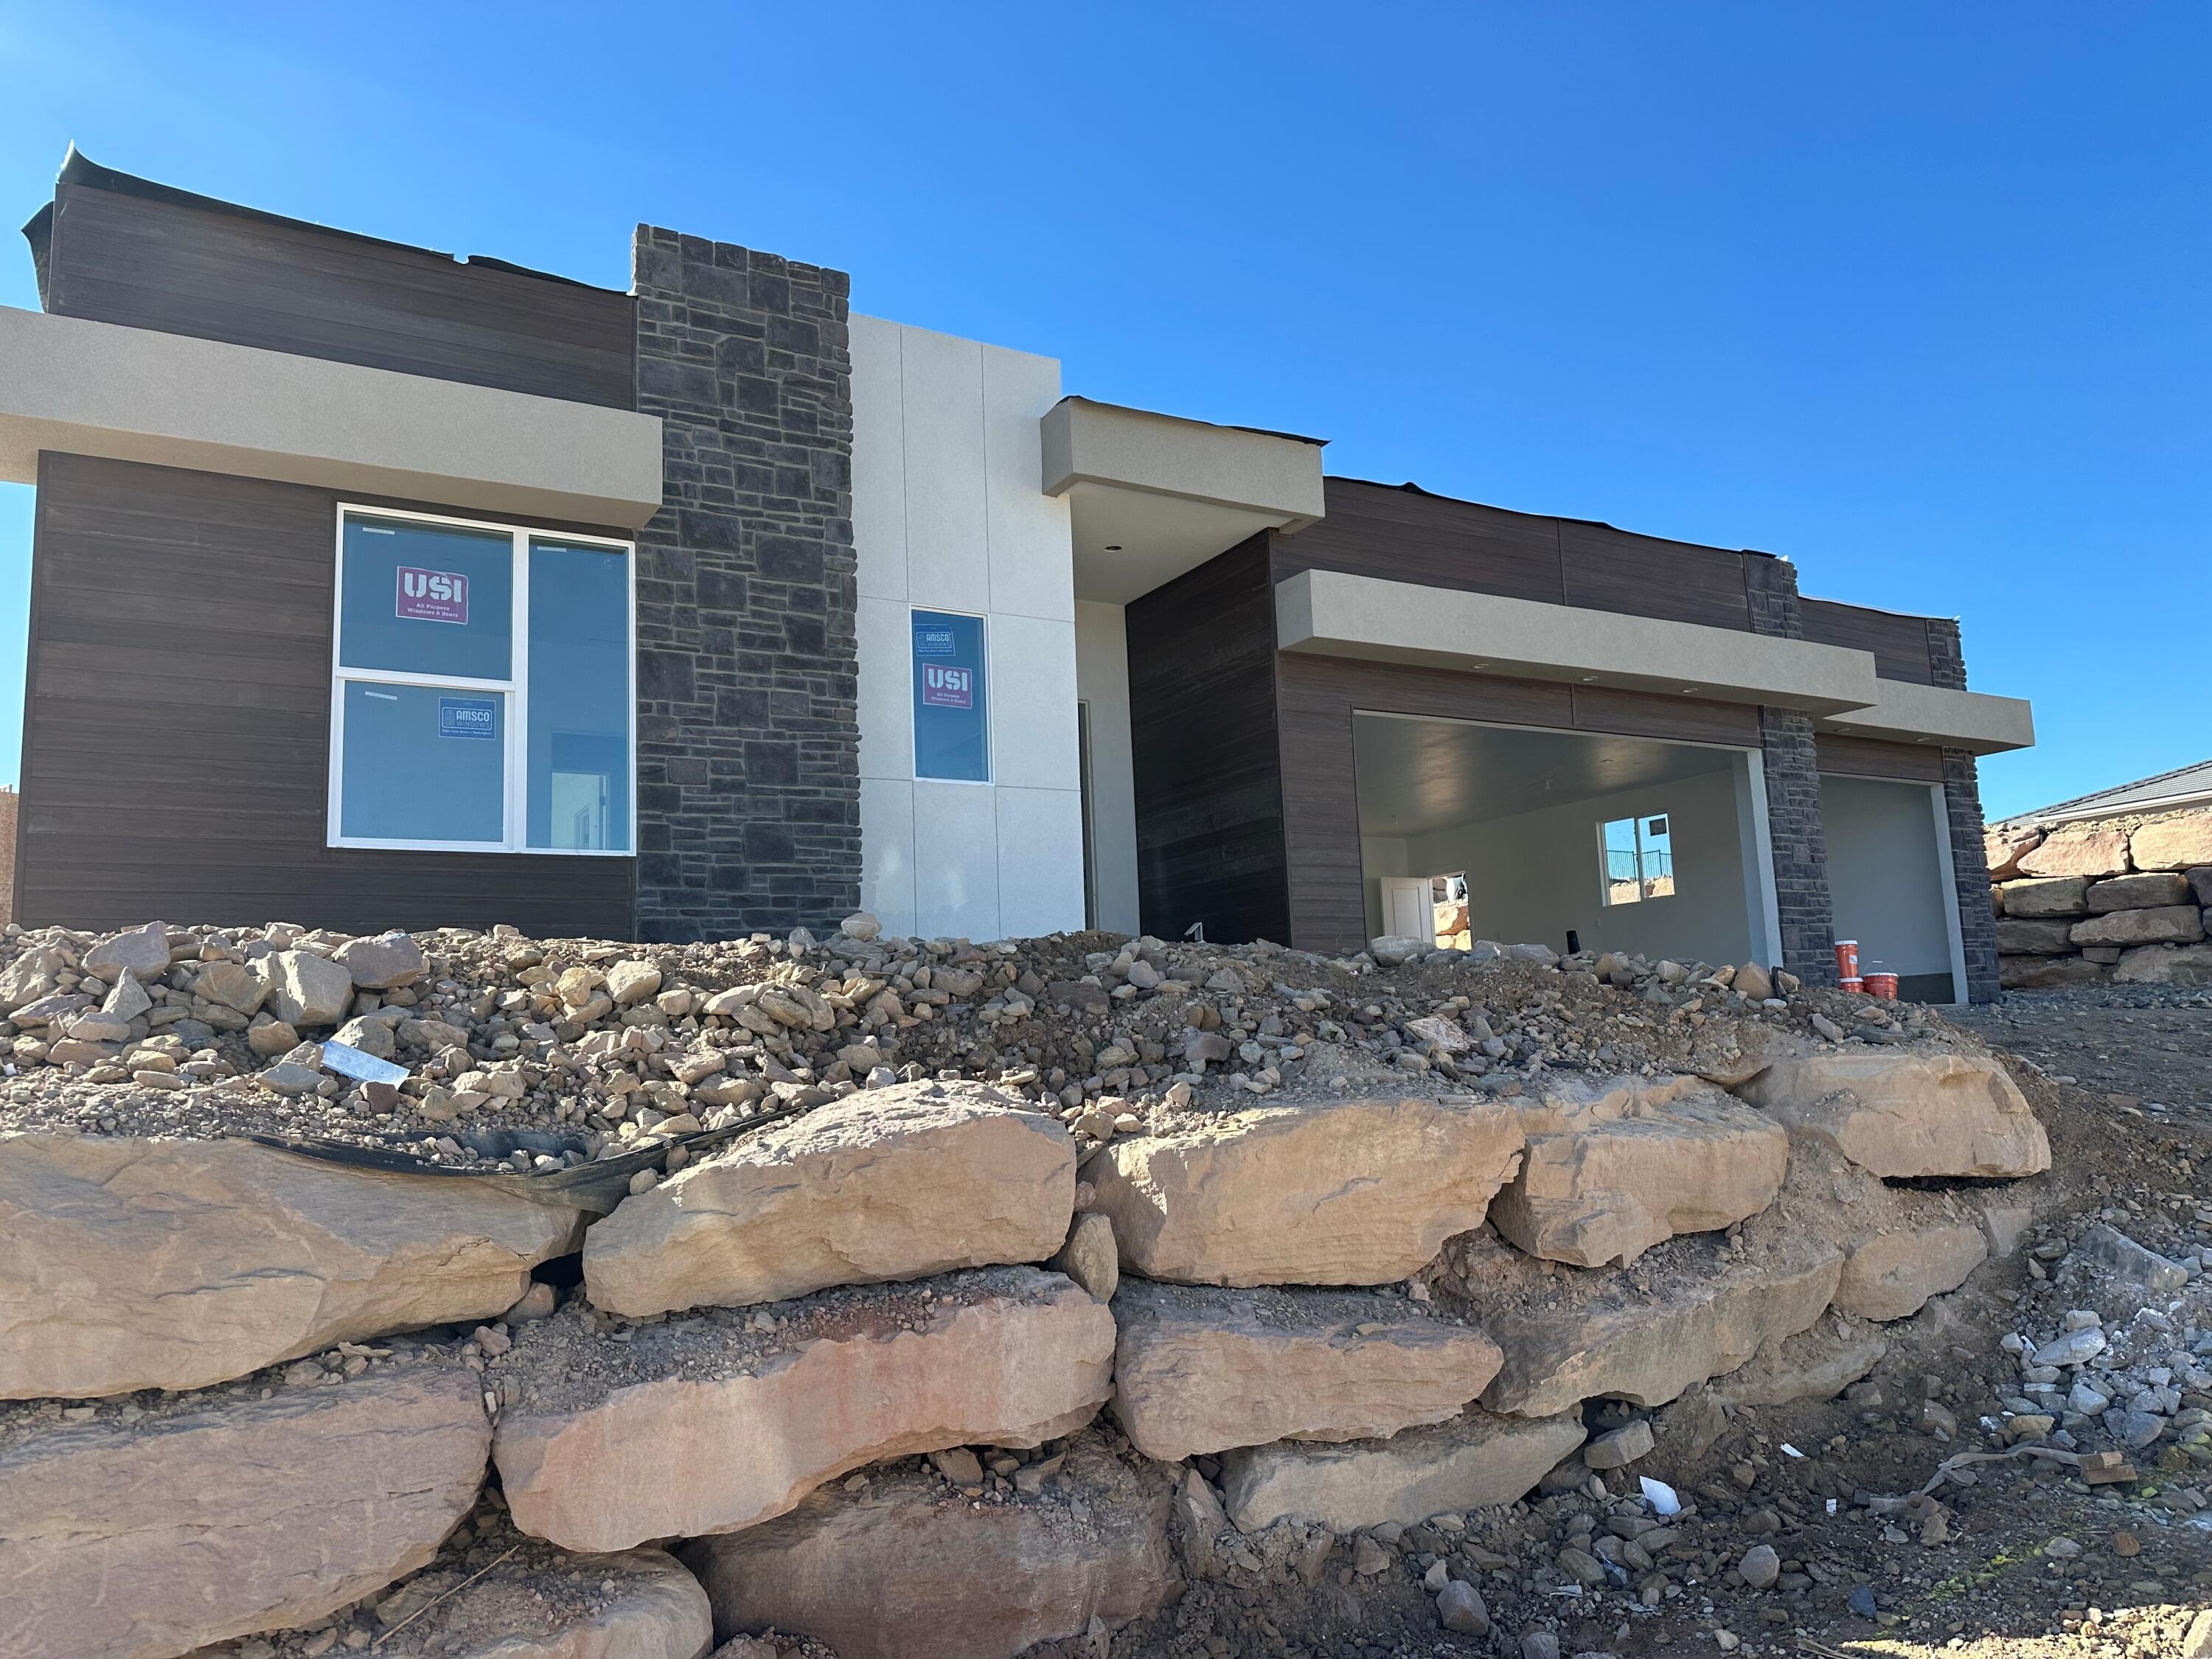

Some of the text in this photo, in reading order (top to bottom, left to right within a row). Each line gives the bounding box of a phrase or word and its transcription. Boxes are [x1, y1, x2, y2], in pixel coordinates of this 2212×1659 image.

[404, 572, 462, 602] USI
[926, 633, 950, 642] AMSCO
[928, 668, 968, 692] USI
[456, 710, 490, 722] AMSCO
